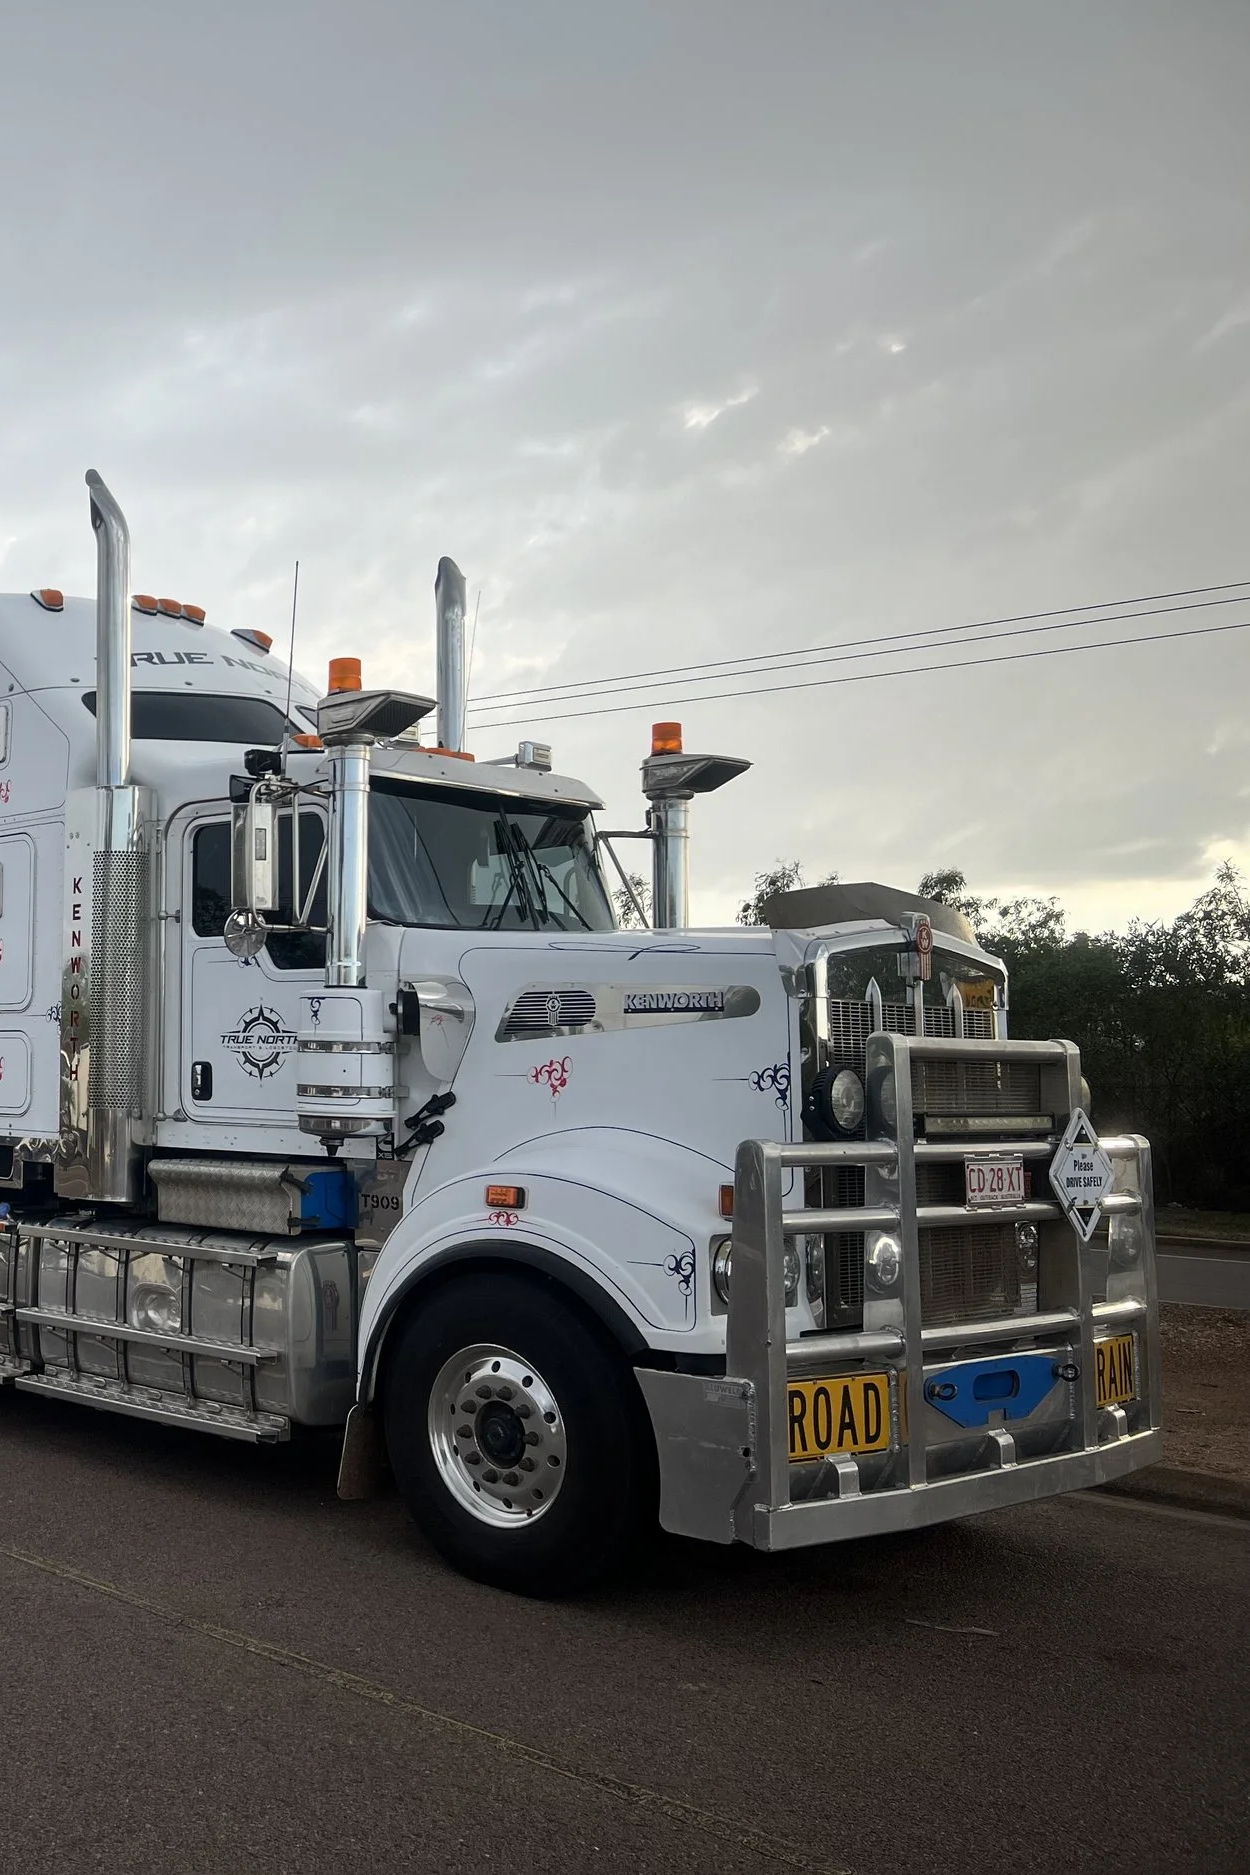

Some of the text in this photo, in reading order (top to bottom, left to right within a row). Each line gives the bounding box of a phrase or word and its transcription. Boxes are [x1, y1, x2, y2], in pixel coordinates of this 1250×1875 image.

[131, 651, 214, 668] RUE
[69, 877, 83, 1081] KENWORTH
[624, 991, 724, 1010] KENWORTH
[220, 1035, 254, 1044] TRUE
[1073, 1159, 1094, 1172] Please
[1066, 1176, 1103, 1188] DRIVE SAFELY
[361, 1194, 400, 1210] T909
[788, 1382, 882, 1453] ROAD
